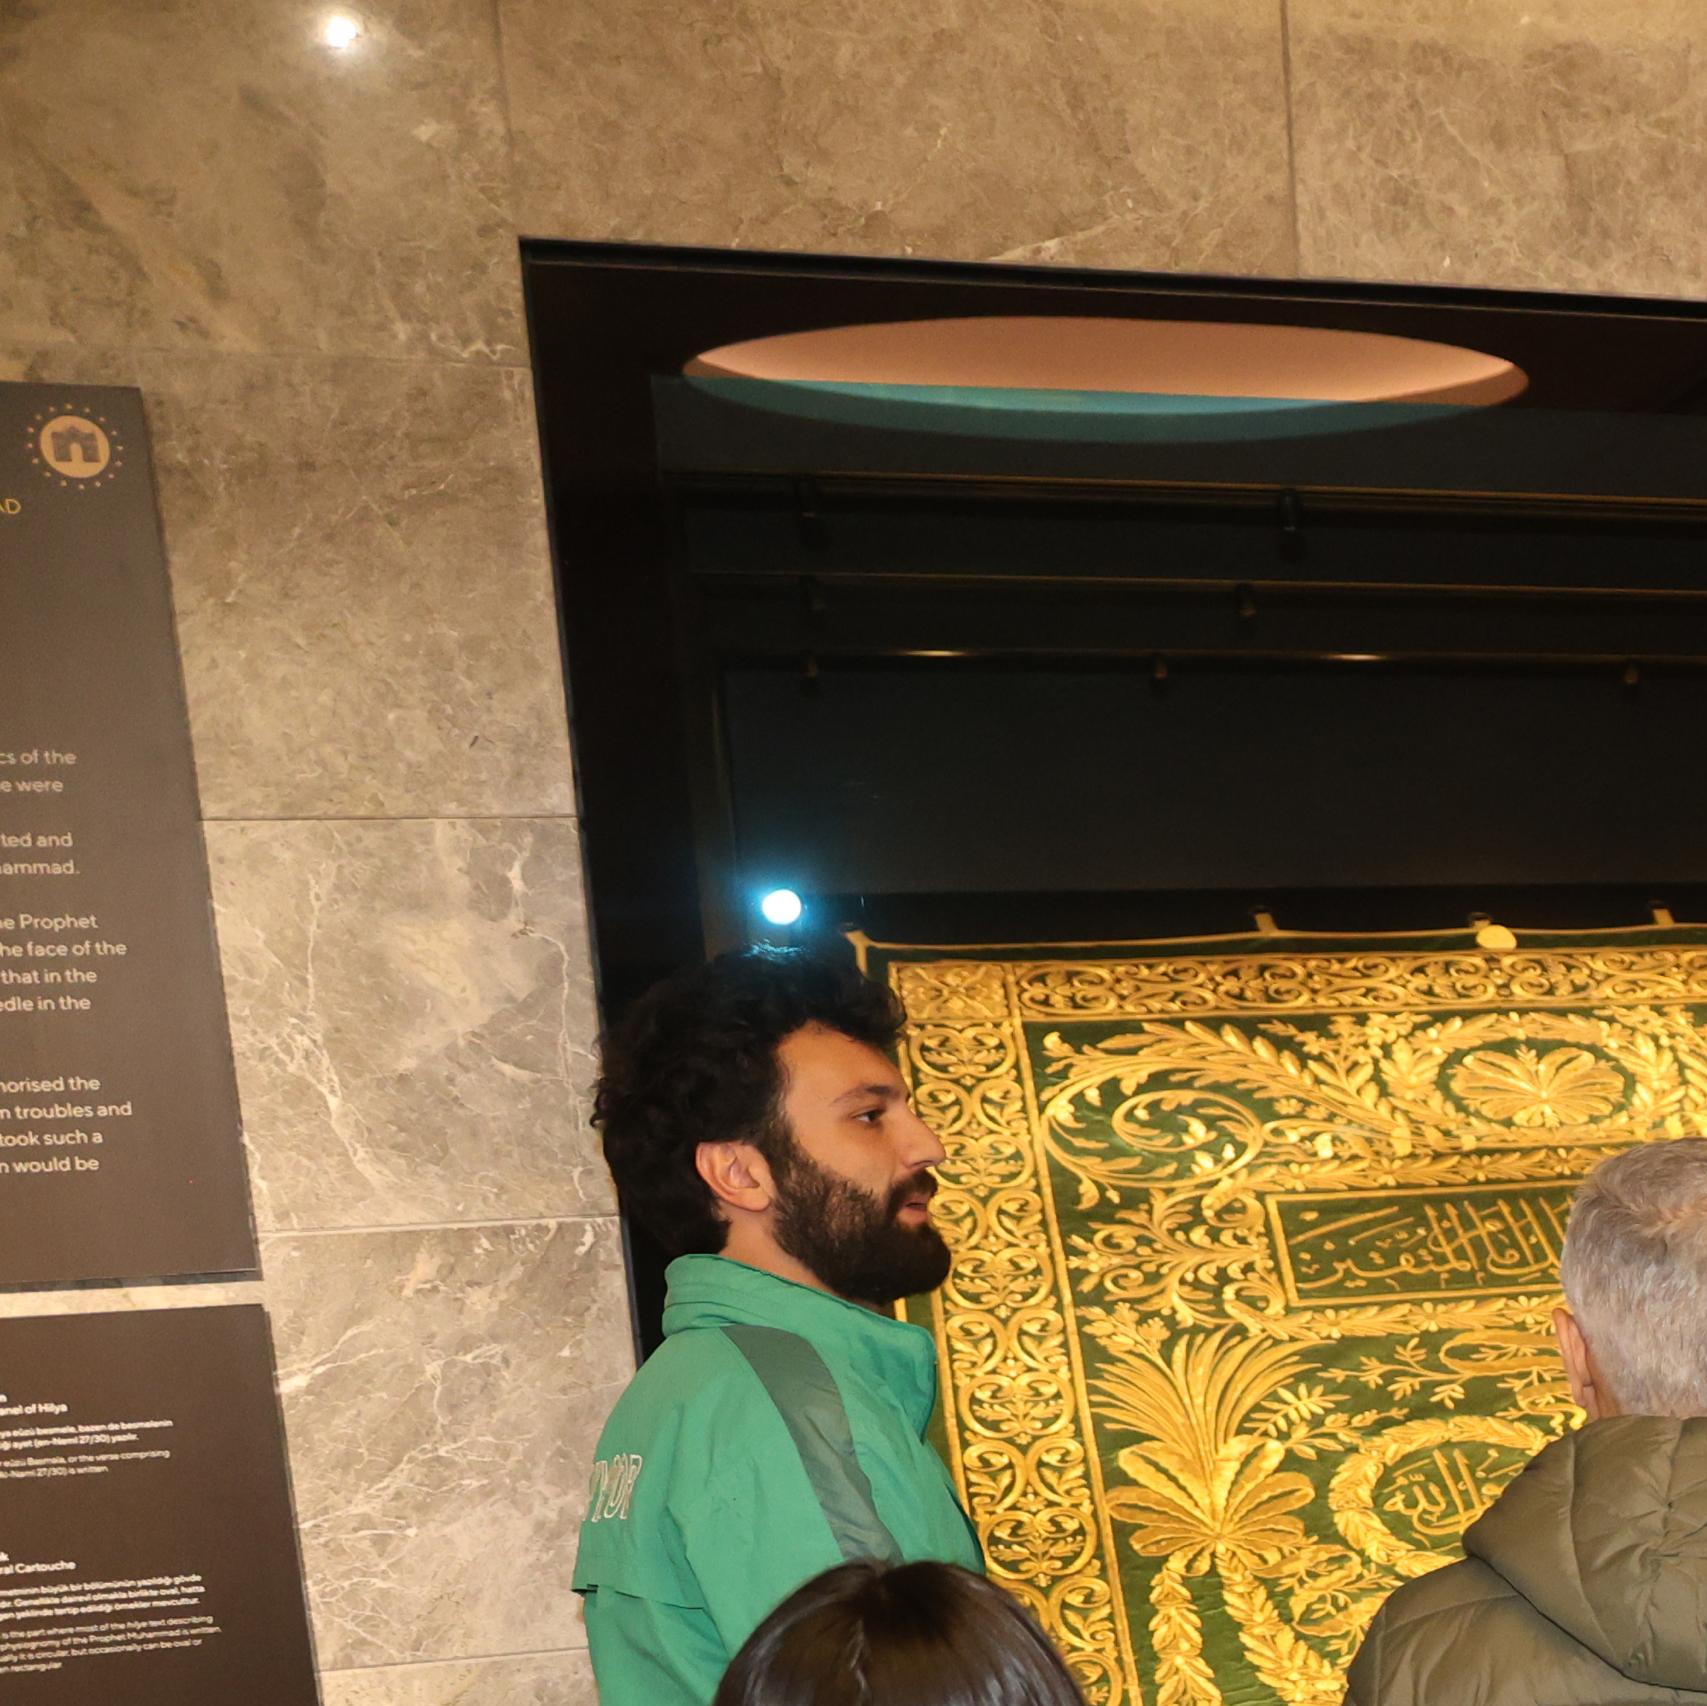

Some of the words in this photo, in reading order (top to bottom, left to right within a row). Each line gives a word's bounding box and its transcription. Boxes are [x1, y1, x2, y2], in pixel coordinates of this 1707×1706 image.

[20, 749, 38, 764] of
[44, 749, 77, 764] the
[16, 780, 64, 792] were
[36, 832, 73, 847] and
[20, 913, 98, 932] Prophet
[26, 941, 68, 957] face
[72, 939, 91, 956] of
[95, 940, 127, 955] the
[0, 969, 40, 984] that
[44, 968, 62, 983] in
[64, 967, 97, 983] the
[37, 996, 55, 1010] in
[59, 995, 92, 1010] the
[68, 1076, 101, 1091] the
[15, 1102, 94, 1120] troubles
[97, 1100, 132, 1116] and
[43, 1129, 88, 1145] such
[91, 1131, 103, 1144] a
[13, 1156, 71, 1173] would
[75, 1156, 100, 1171] be
[15, 1561, 77, 1573] Cartouche
